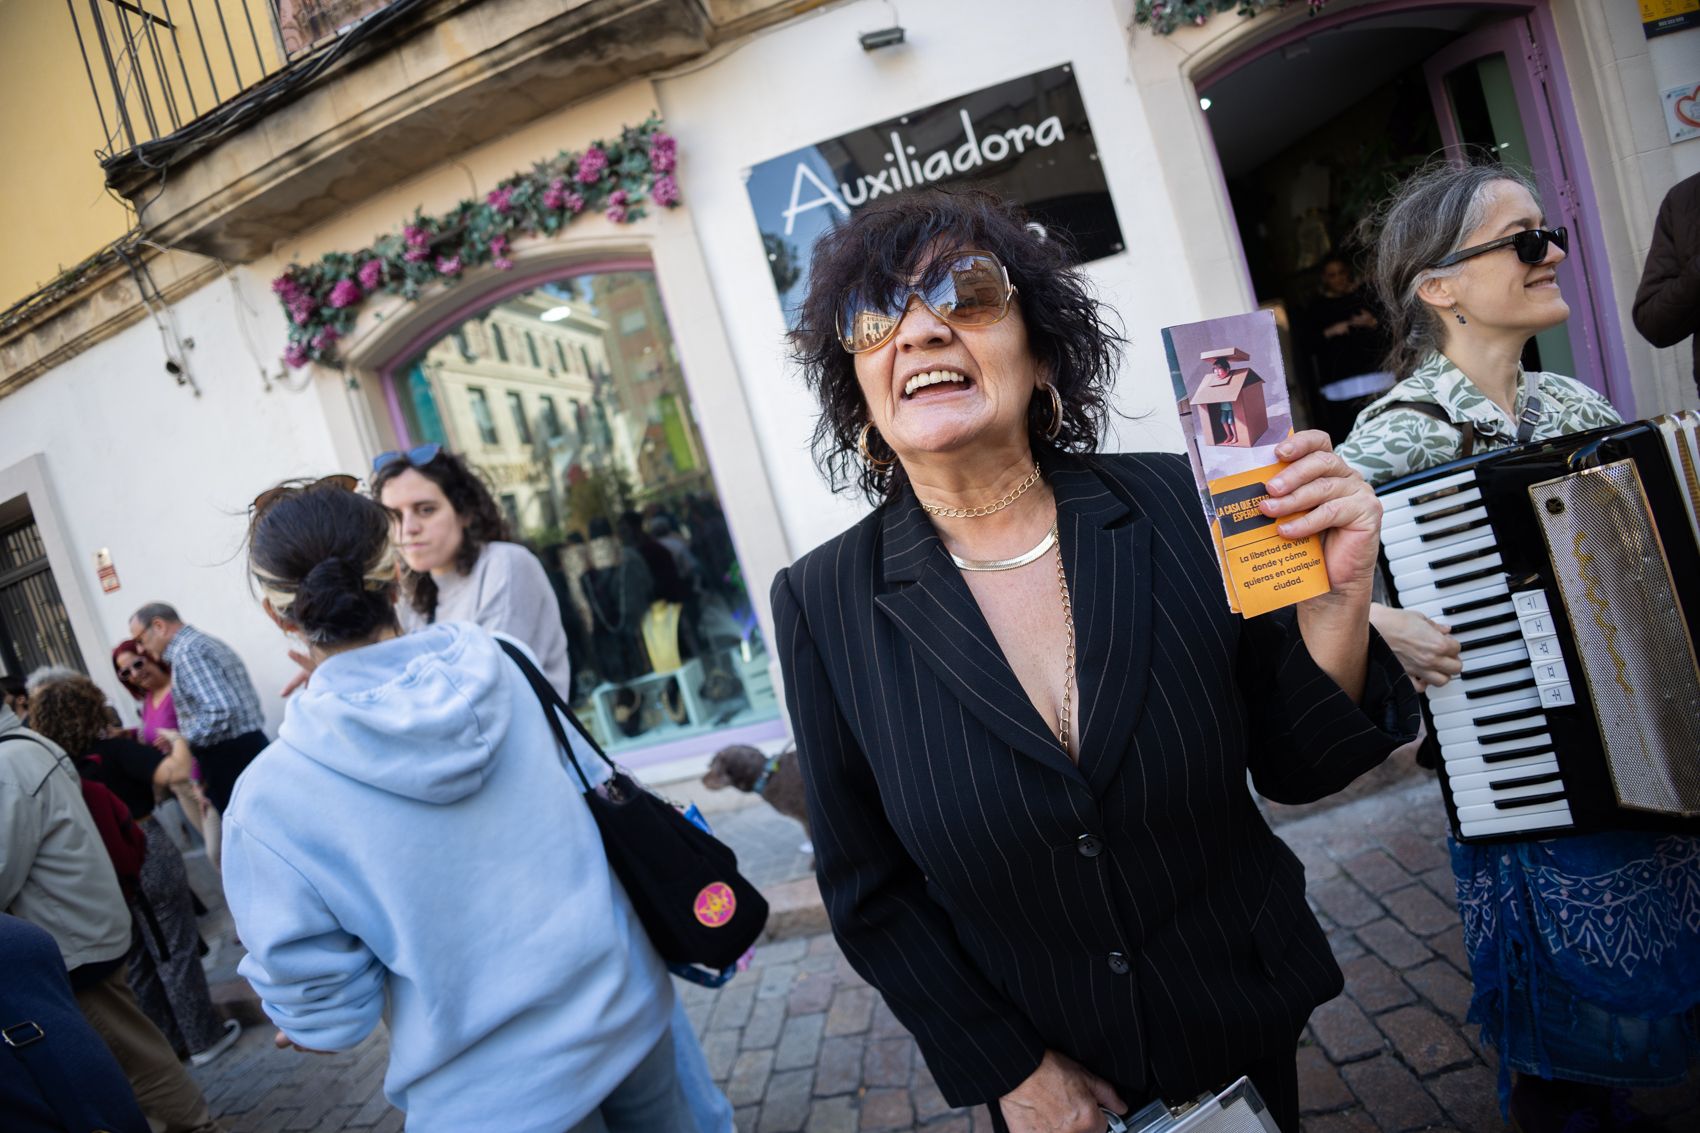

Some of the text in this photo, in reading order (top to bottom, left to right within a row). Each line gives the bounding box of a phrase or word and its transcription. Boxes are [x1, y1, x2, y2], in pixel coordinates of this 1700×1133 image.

[782, 109, 1065, 236] Auxiliadora
[1216, 507, 1225, 518] LA
[1223, 502, 1241, 515] CASA
[1239, 499, 1253, 511] QUE
[1239, 535, 1310, 563] La libertad de vivir
[1252, 550, 1308, 572] donde y cómo
[1243, 558, 1321, 589] quieras en cualquier
[1273, 576, 1304, 591] ciudad.
